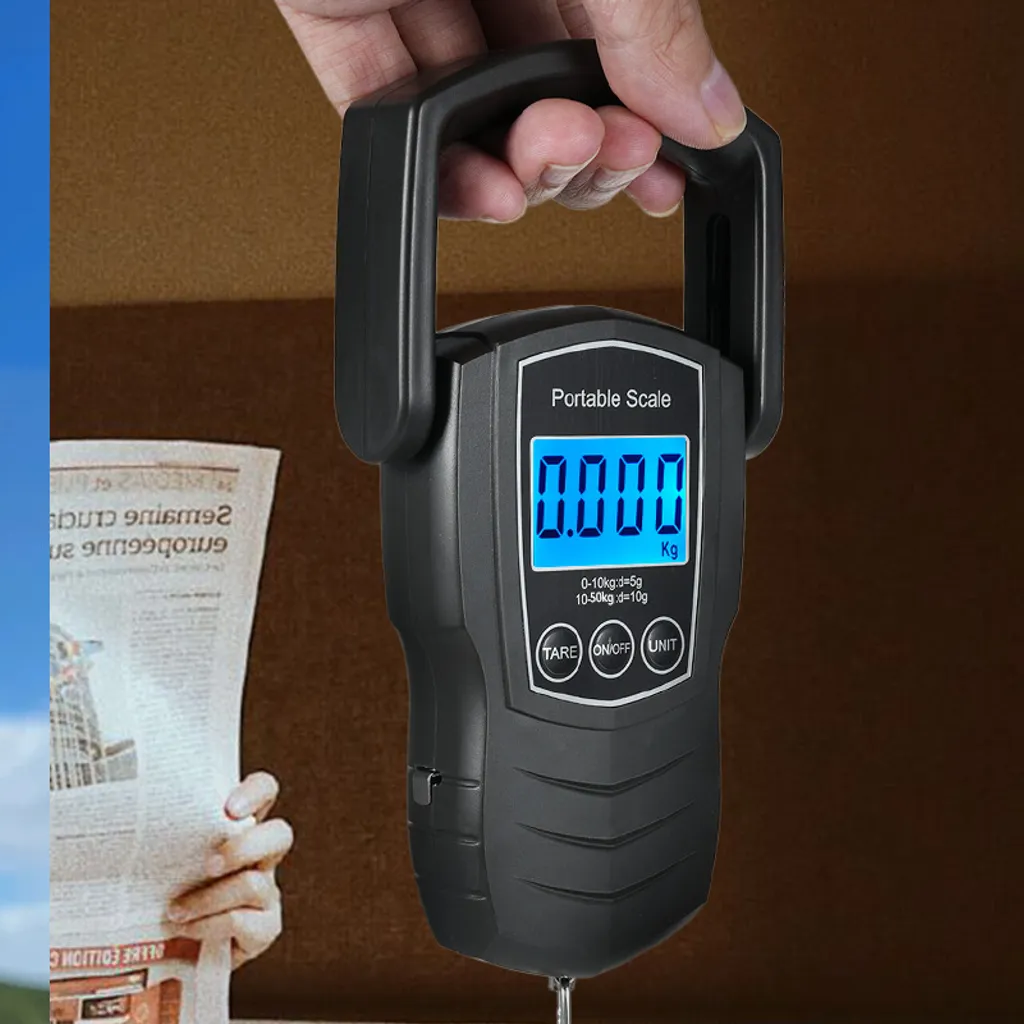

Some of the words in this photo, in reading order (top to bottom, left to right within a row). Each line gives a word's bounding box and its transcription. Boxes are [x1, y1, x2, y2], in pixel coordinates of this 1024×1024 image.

[551, 388, 621, 408] Portable
[626, 389, 672, 408] Scale
[536, 454, 684, 539] 0.000
[661, 541, 679, 559] Kg
[581, 575, 642, 590] 0-10kg:d=5g
[542, 645, 578, 660] TARE
[593, 642, 631, 656] ON/OFF
[648, 638, 678, 653] UNIT
